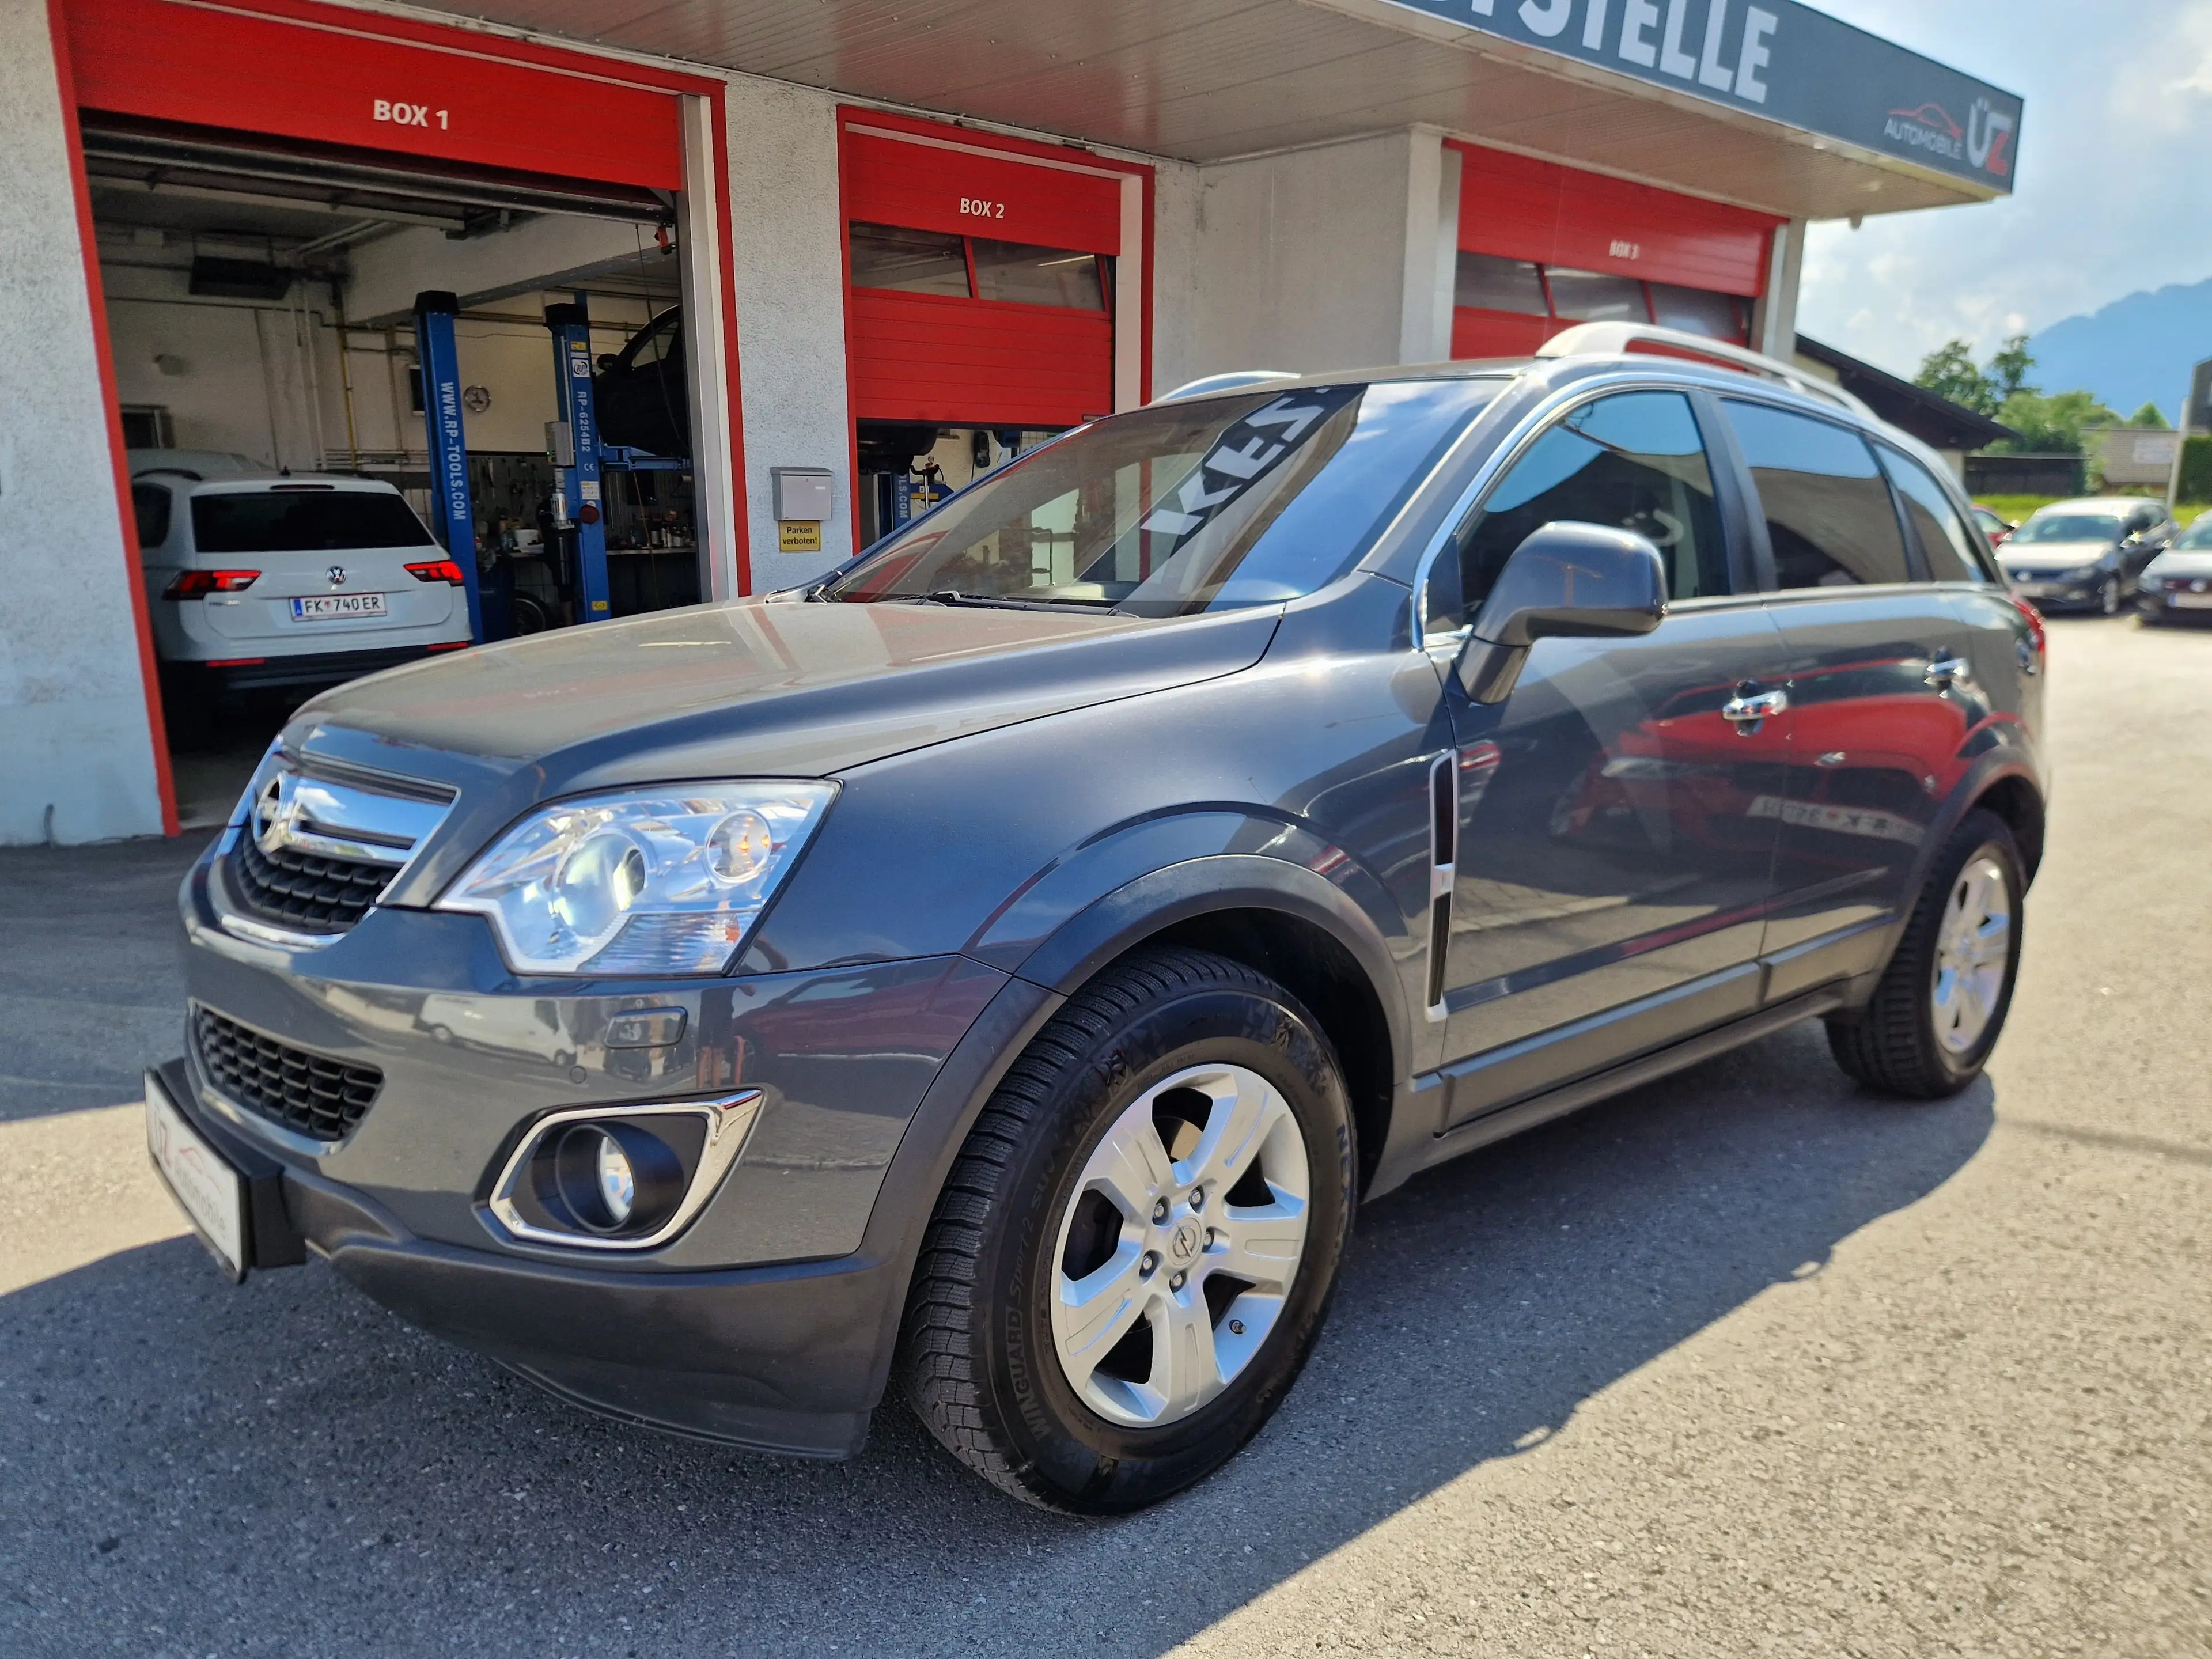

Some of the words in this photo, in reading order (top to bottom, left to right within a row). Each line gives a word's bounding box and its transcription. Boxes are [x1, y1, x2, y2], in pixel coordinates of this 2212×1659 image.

[1471, 0, 1778, 104] TELLE
[373, 99, 429, 128] BOX
[435, 109, 448, 130] 1
[1883, 117, 1963, 160] AUTOMOBILE
[960, 198, 992, 217] BOX
[995, 204, 1005, 219] 2
[1609, 239, 1630, 259] BOX
[441, 382, 466, 520] WWW.RP-TOOLS.COM
[305, 600, 323, 613] FK
[334, 598, 359, 612] 740
[363, 597, 380, 610] ER
[1009, 1232, 1030, 1306] Sport
[1005, 1304, 1052, 1442] WINGUARD
